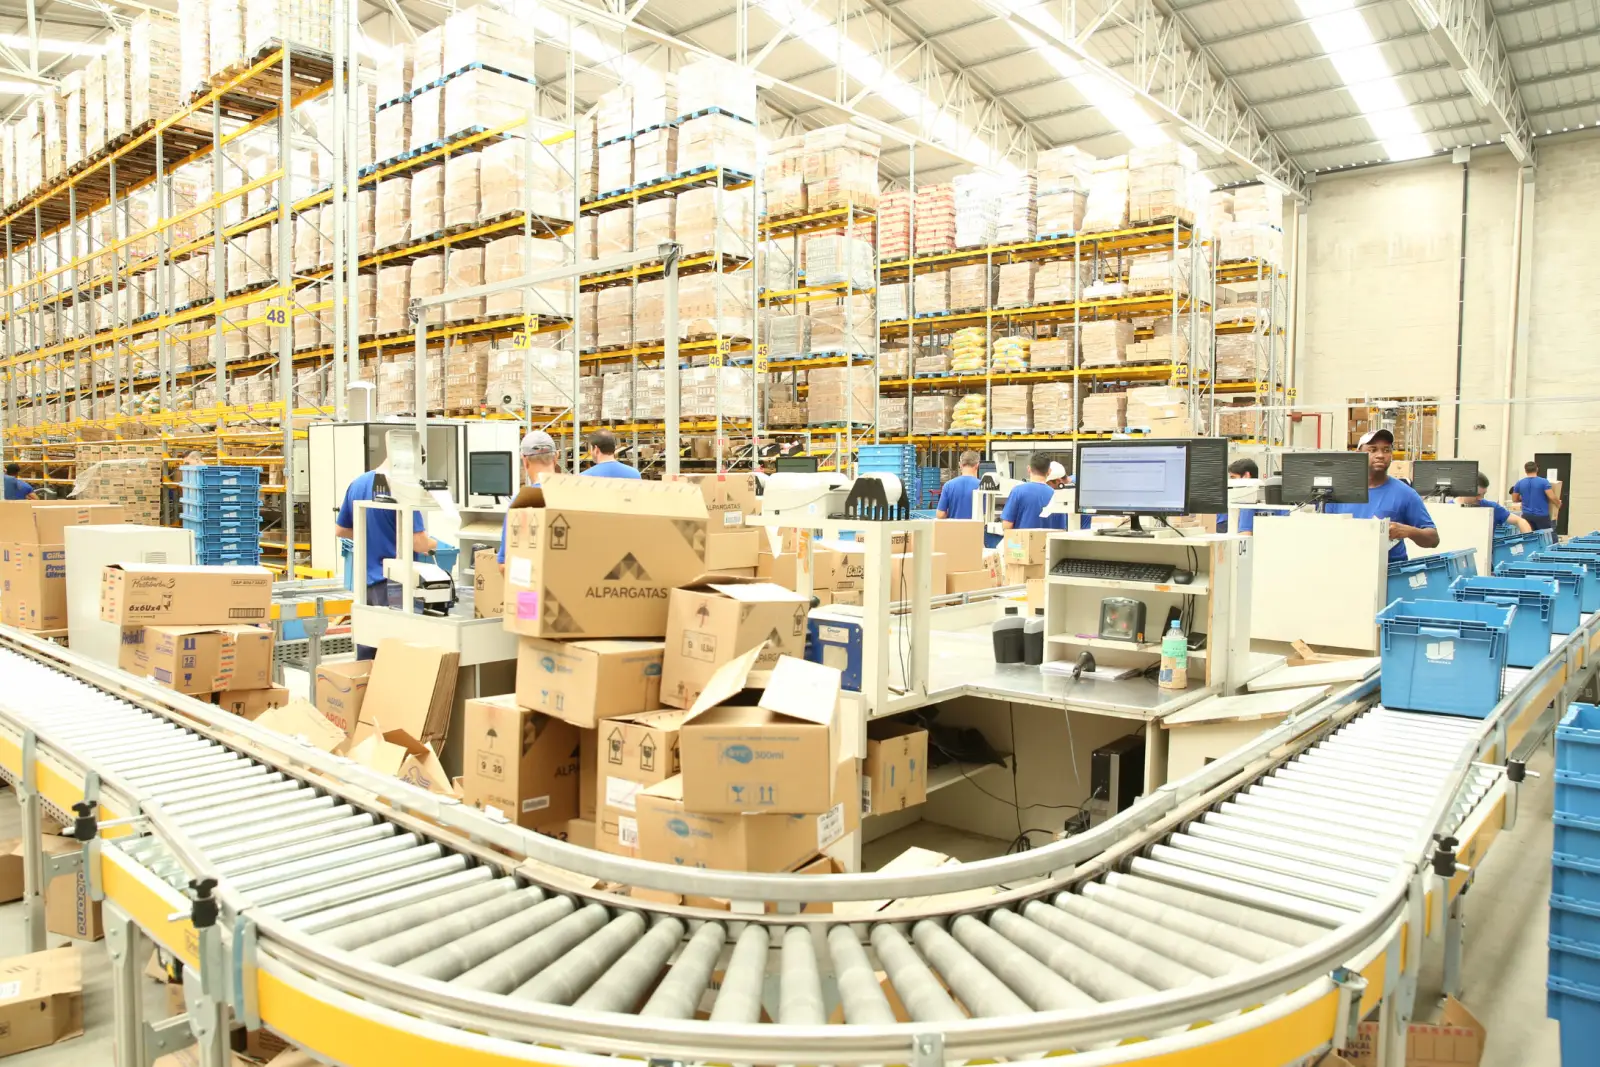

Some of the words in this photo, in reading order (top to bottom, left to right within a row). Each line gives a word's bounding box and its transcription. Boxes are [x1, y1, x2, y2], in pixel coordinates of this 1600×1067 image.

[267, 309, 285, 324] 48
[529, 317, 538, 328] 47
[514, 334, 527, 347] 47
[720, 341, 730, 351] 46
[758, 346, 768, 355] 45
[710, 356, 720, 367] 46
[758, 361, 767, 371] 45
[1176, 366, 1187, 375] 44
[1260, 383, 1269, 391] 43
[1287, 389, 1297, 397] 42
[1238, 540, 1247, 556] 04
[585, 586, 668, 599] ALPARGATAS
